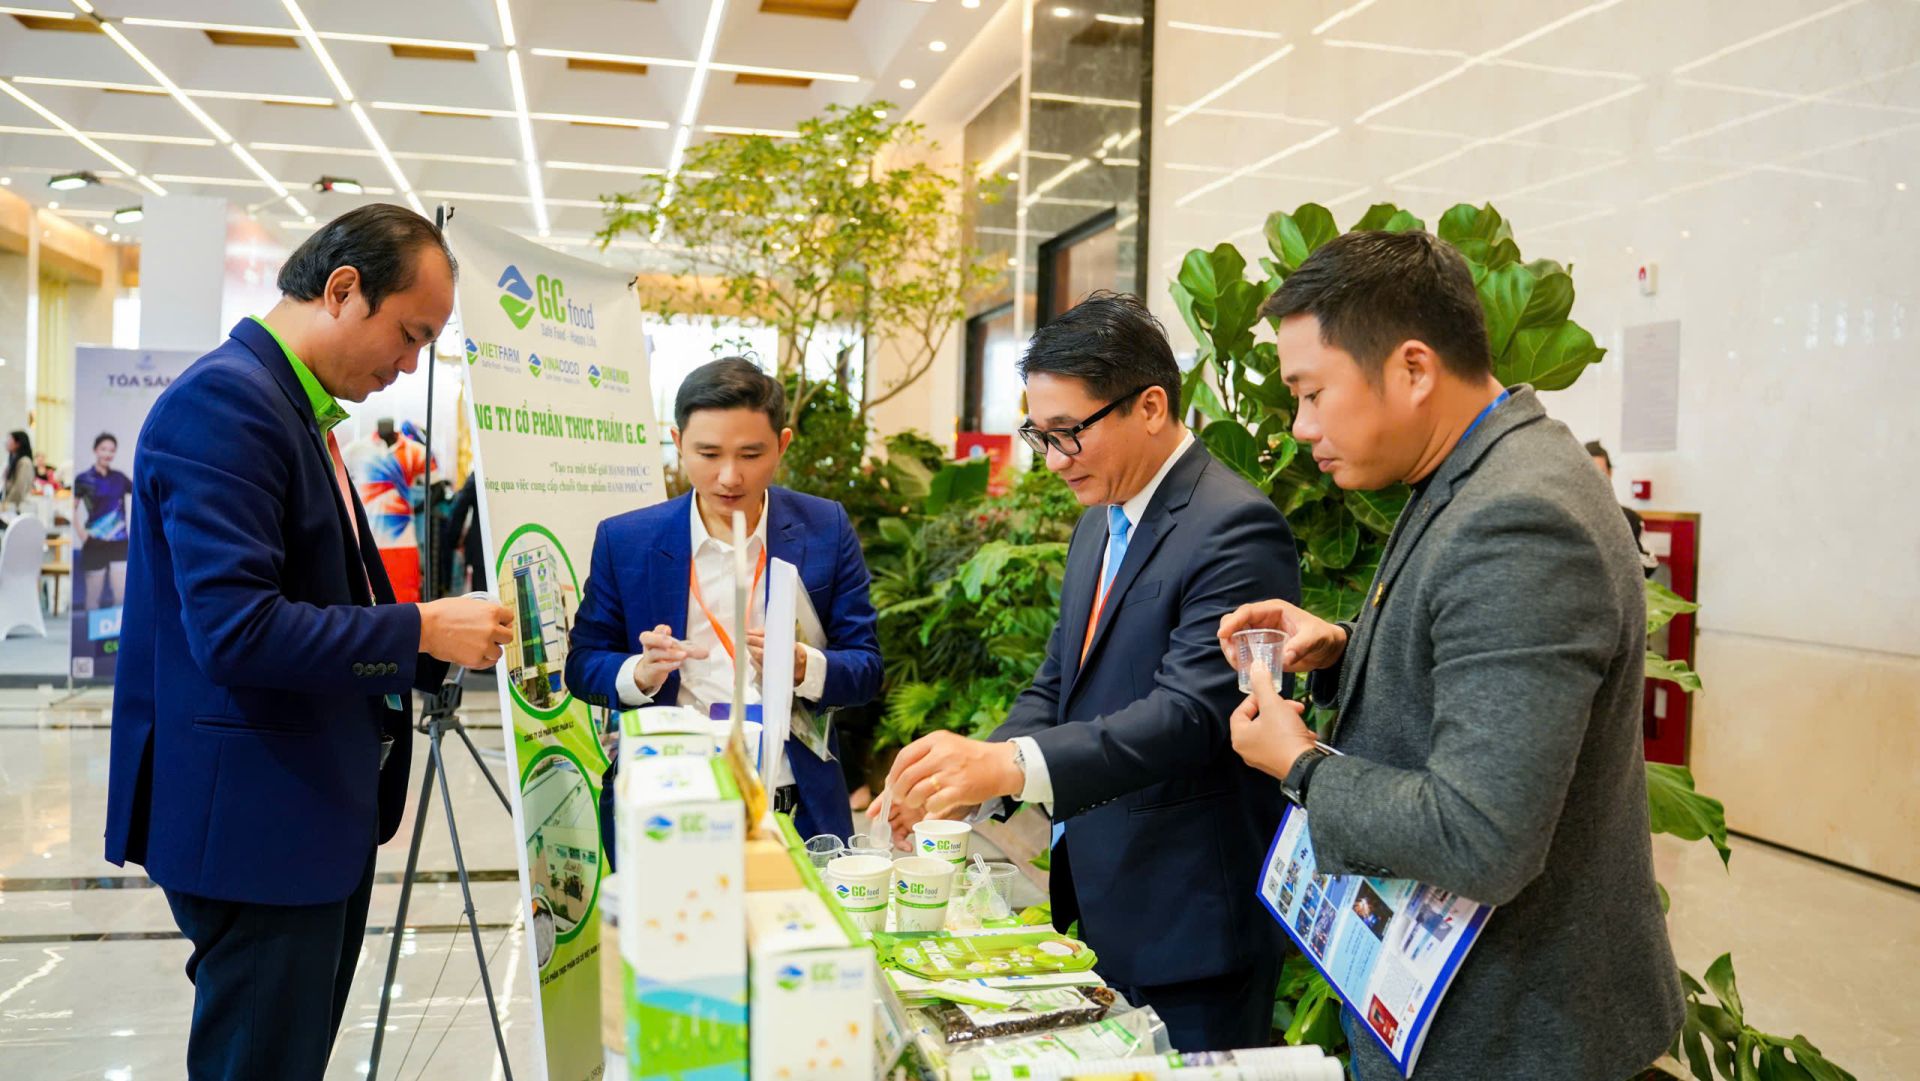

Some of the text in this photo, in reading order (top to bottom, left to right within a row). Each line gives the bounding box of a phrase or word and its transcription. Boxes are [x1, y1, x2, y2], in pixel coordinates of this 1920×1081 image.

[536, 274, 595, 330] GC food
[478, 341, 520, 364] VIETFARM
[495, 406, 512, 433] TY
[500, 481, 515, 493] qua
[937, 840, 962, 850] GC food
[851, 885, 880, 897] GC food
[910, 882, 939, 895] GC food
